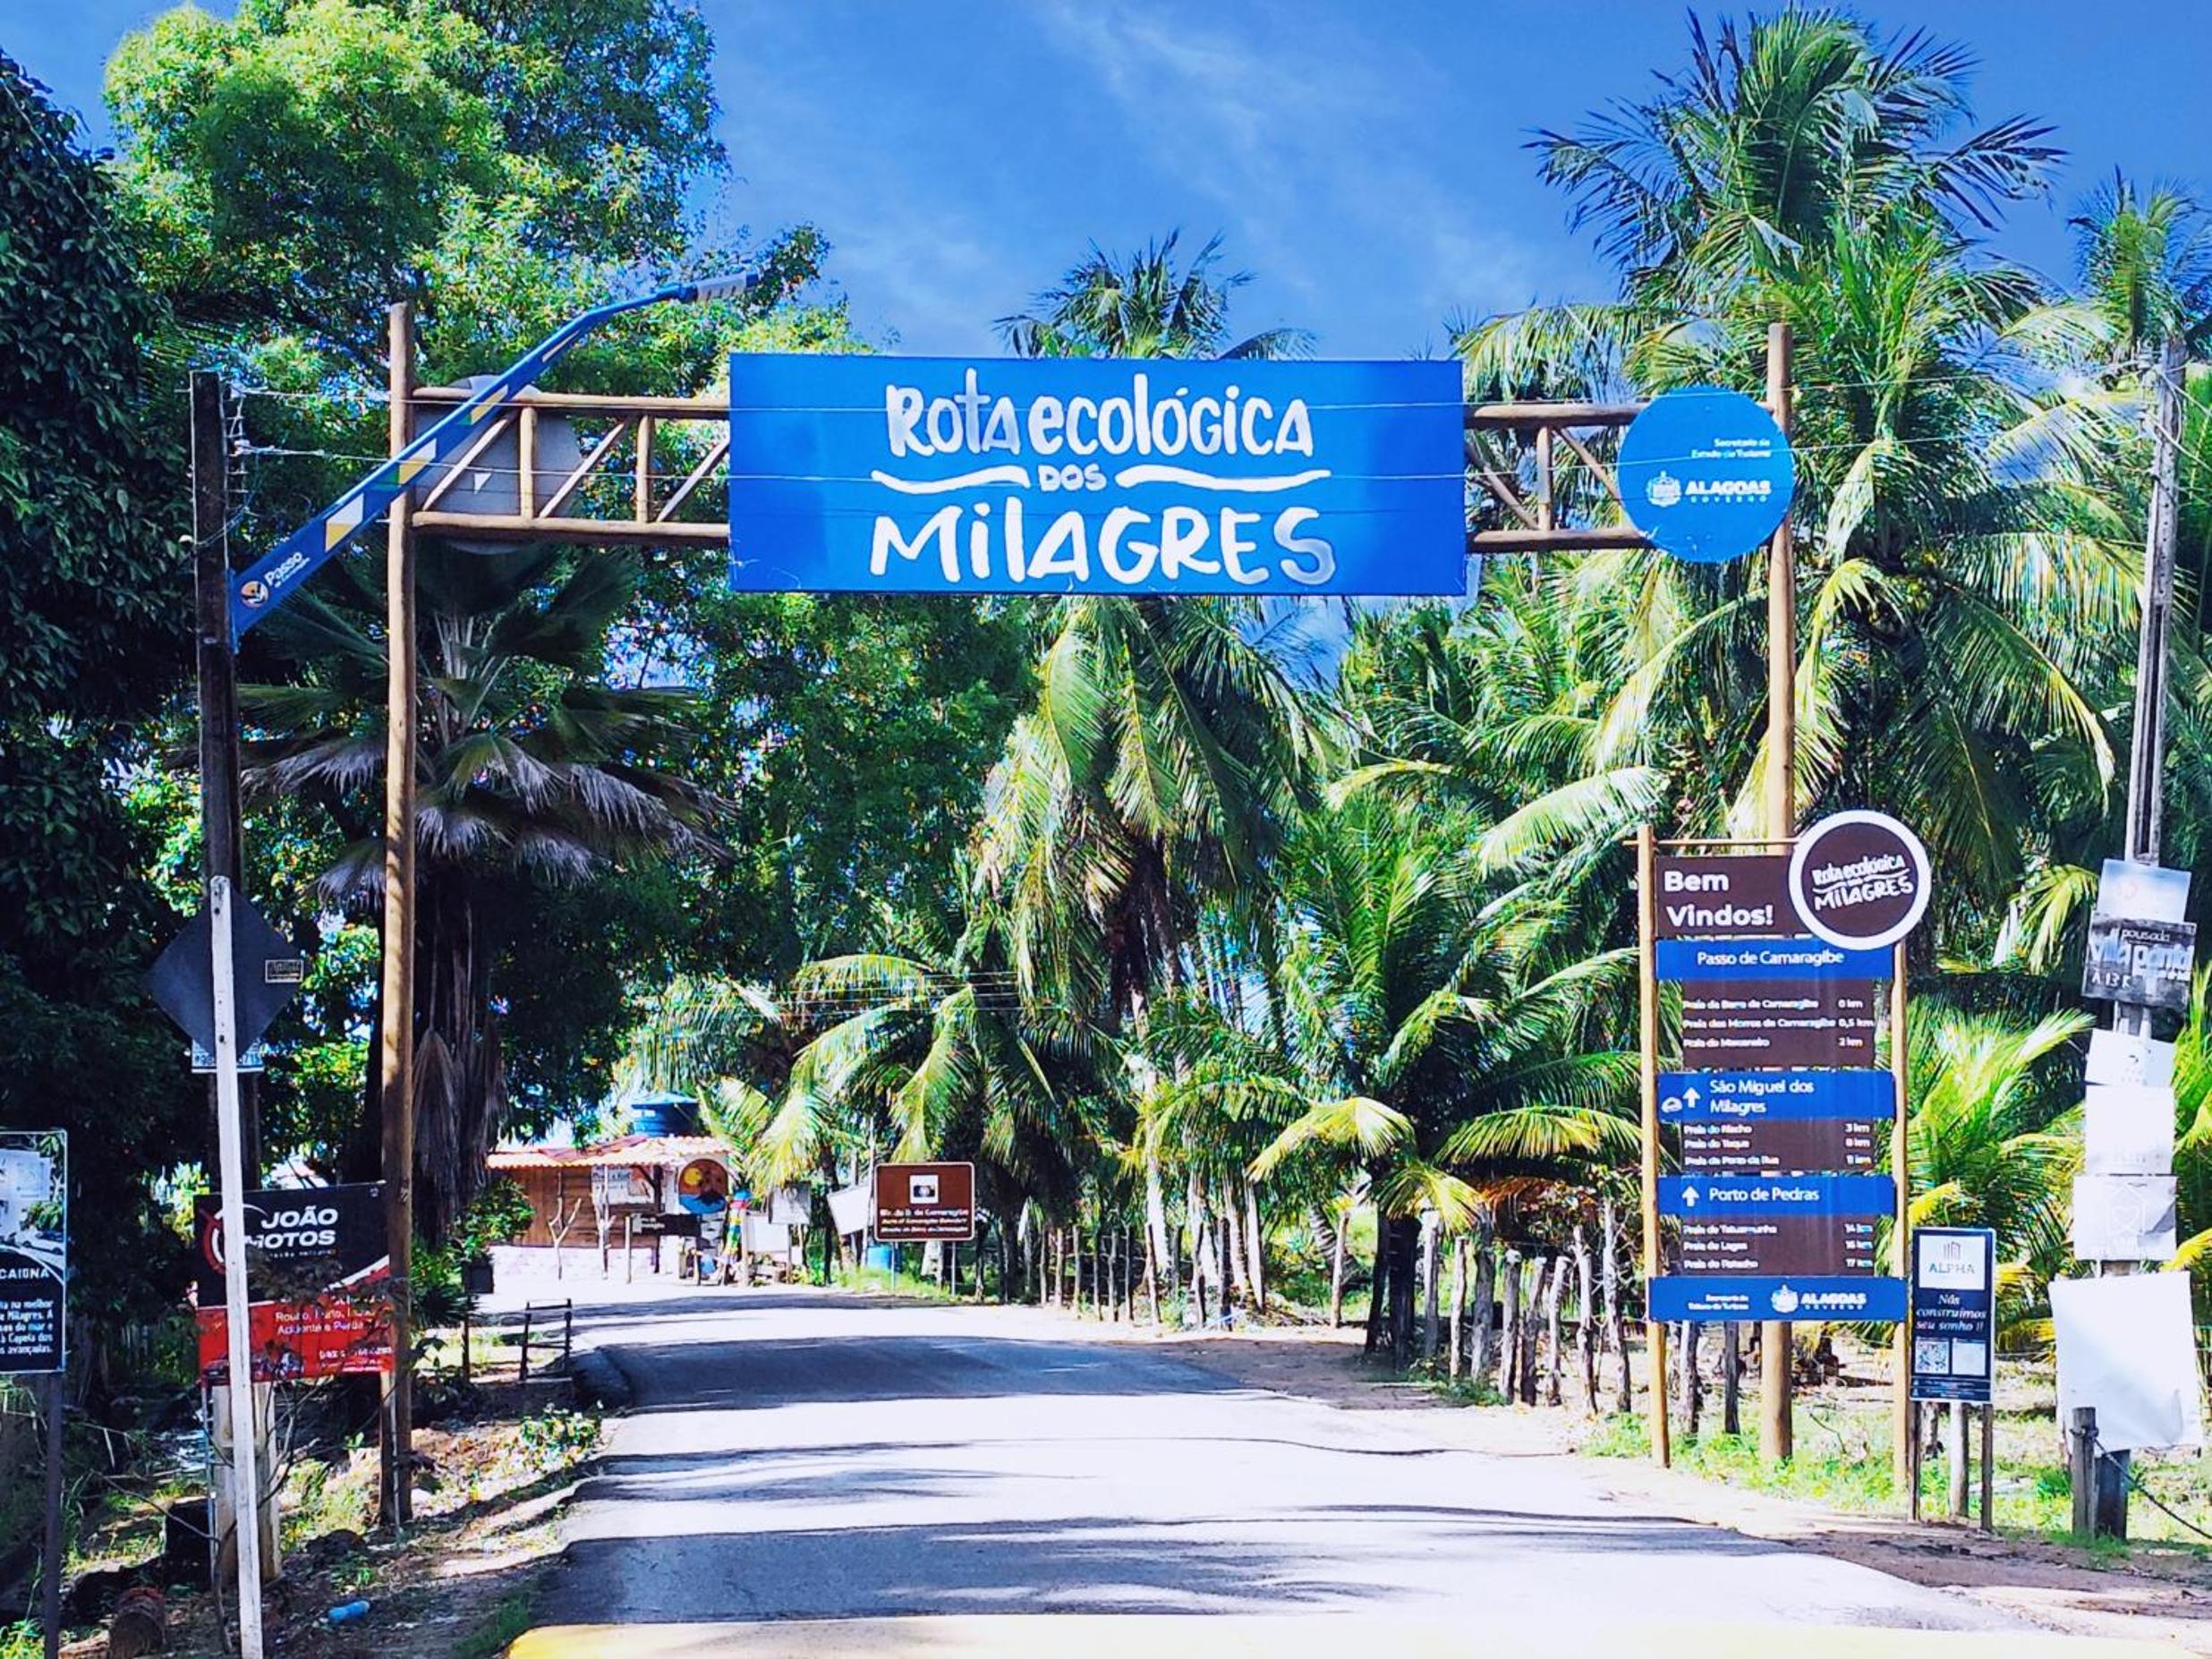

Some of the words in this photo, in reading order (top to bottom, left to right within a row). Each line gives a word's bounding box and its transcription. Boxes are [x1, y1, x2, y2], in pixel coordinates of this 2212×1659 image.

[1684, 479, 1772, 496] ALAGOAS
[264, 551, 303, 586] Passo
[1663, 870, 1730, 893] Bem
[1666, 904, 1774, 927] Vindos!
[2121, 927, 2170, 942] pousada
[1697, 950, 1737, 966] Passo
[1739, 950, 1758, 966] de
[1760, 949, 1845, 968] Camaragibe
[1682, 999, 1706, 1009] Praia
[1762, 999, 1819, 1009] Camaragibe
[1847, 1000, 1863, 1008] km
[1683, 1018, 1706, 1028] Praia
[1777, 1018, 1836, 1028] Camaragibe
[1856, 1019, 1874, 1029] km
[1682, 1037, 1706, 1048] Praia
[1846, 1038, 1863, 1047] km
[1710, 1079, 1736, 1093] São
[1738, 1079, 1785, 1096] Miguel
[1789, 1079, 1816, 1093] dos
[1710, 1099, 1767, 1117] Milagres
[1683, 1125, 1706, 1135] Praia
[1845, 1124, 1852, 1133] 3
[1853, 1124, 1870, 1133] km
[1684, 1139, 1706, 1149] Praia
[1854, 1138, 1871, 1147] km
[1684, 1155, 1707, 1165] Praia
[1854, 1155, 1872, 1165] km
[1709, 1187, 1748, 1202] Porto
[1749, 1187, 1769, 1201] de
[1772, 1187, 1820, 1201] Pedras
[260, 1204, 339, 1229] JOÃO
[1683, 1224, 1706, 1234] Praia
[1857, 1223, 1874, 1233] km
[1683, 1241, 1706, 1251] Praia
[1857, 1239, 1874, 1249] km
[1684, 1259, 1706, 1269] Praia
[1857, 1258, 1874, 1268] km
[1928, 1263, 1976, 1274] ALPHA
[1800, 1293, 1867, 1305] ALAGOAS
[1938, 1293, 1961, 1306] Nós
[1915, 1320, 1936, 1331] seu
[1938, 1320, 1974, 1331] sonho
